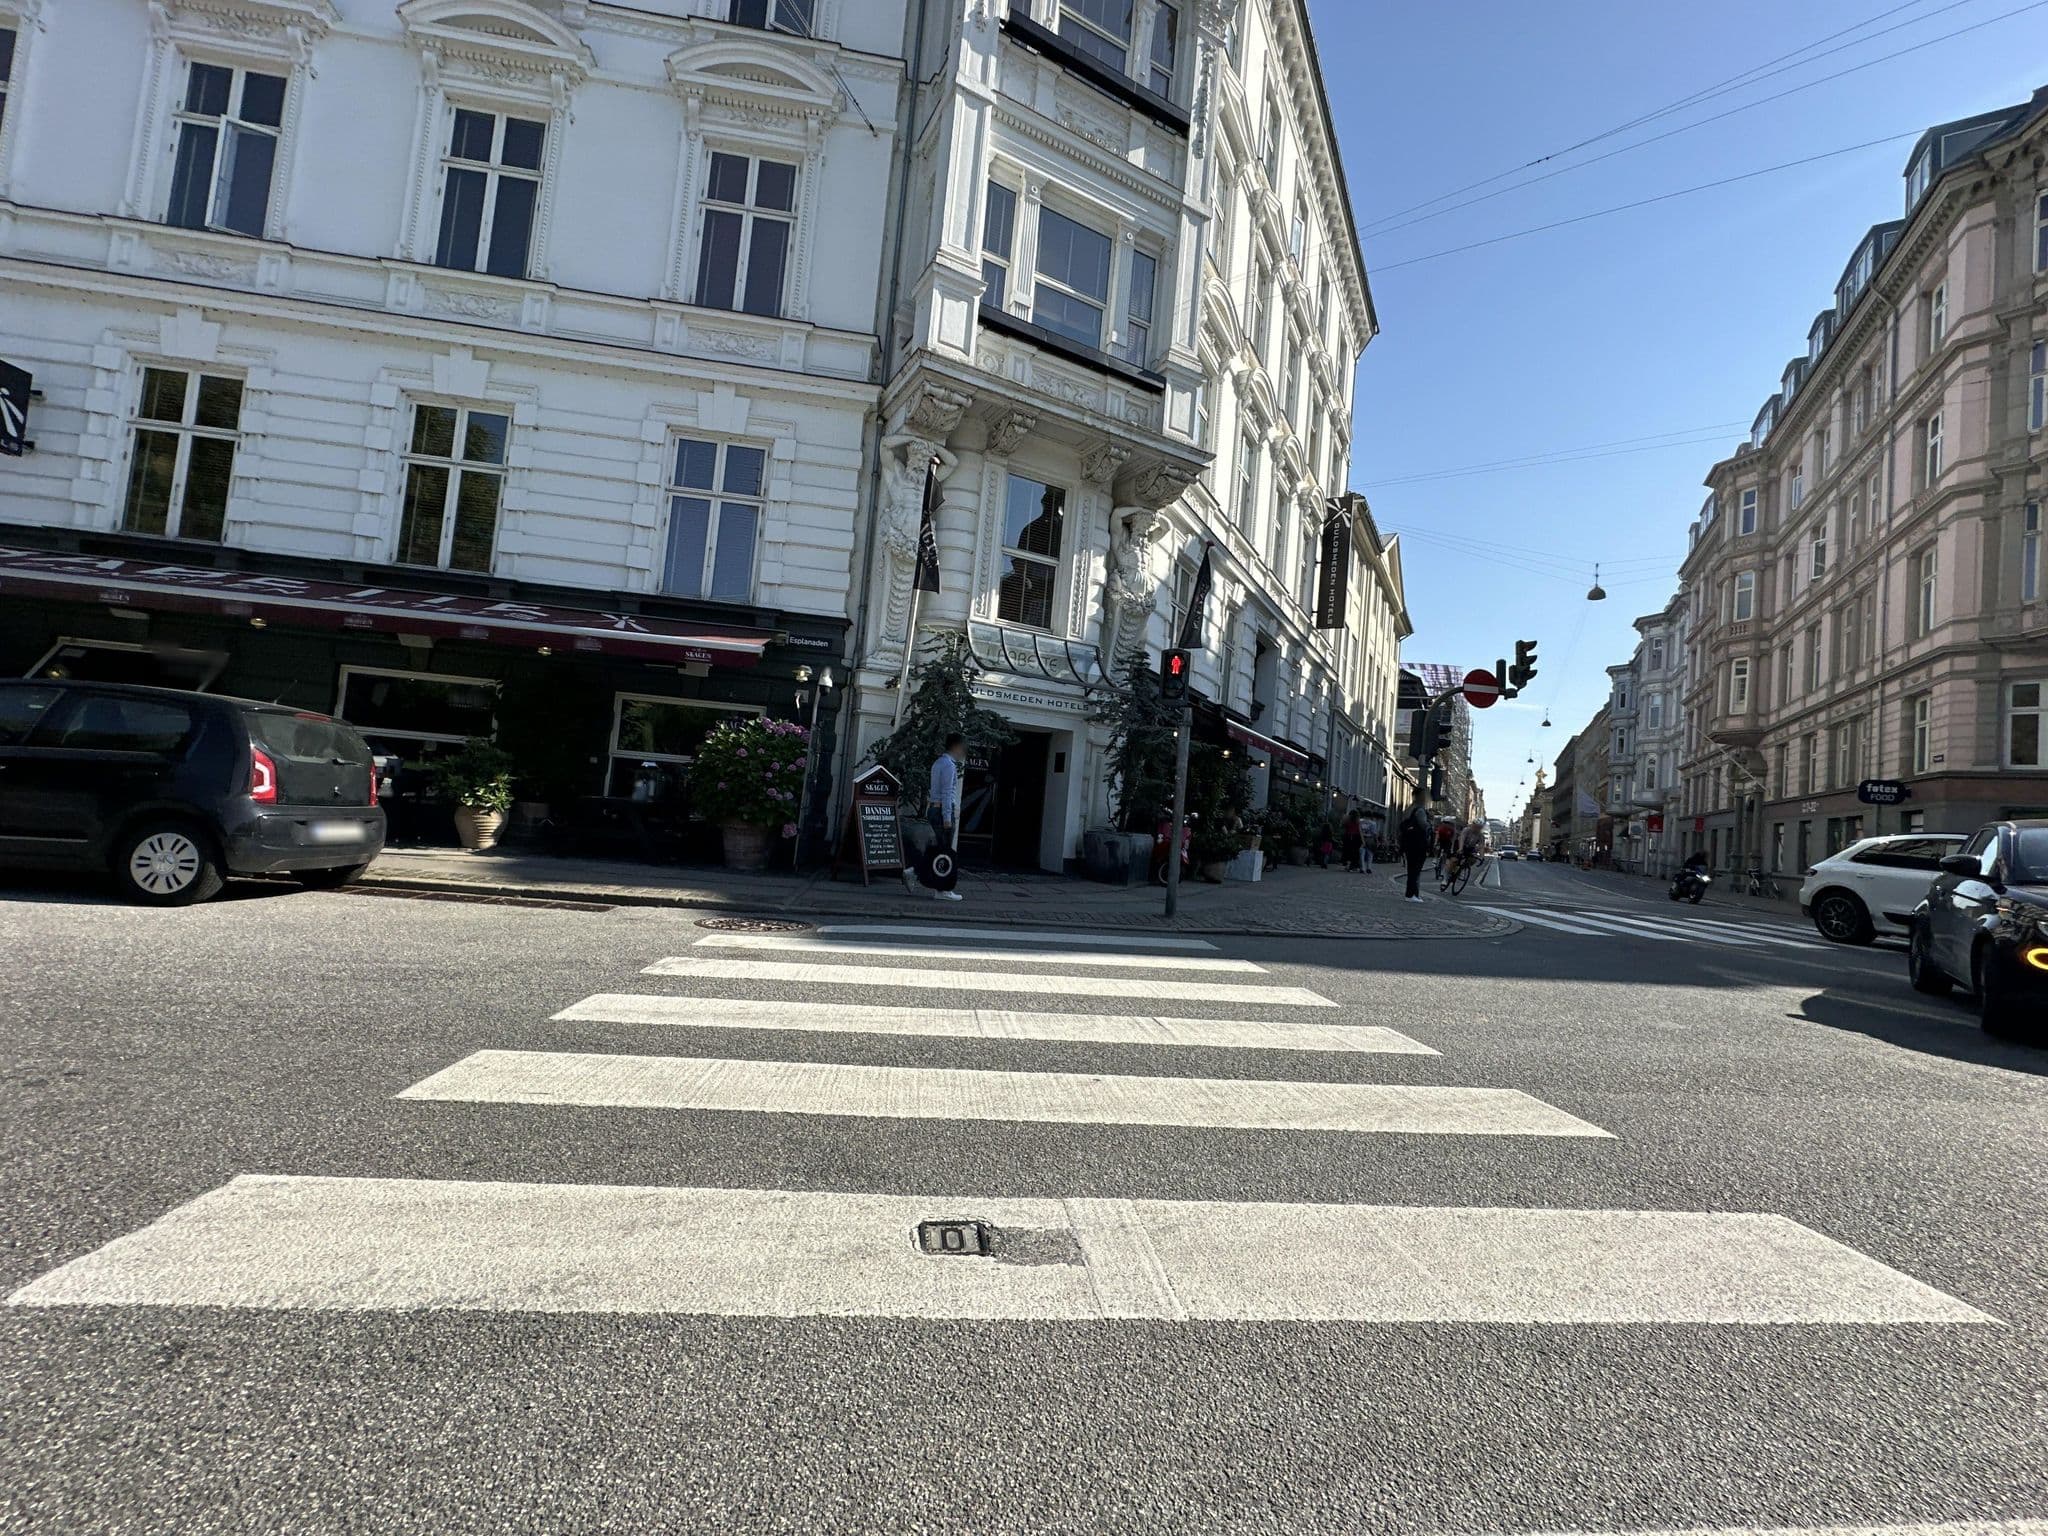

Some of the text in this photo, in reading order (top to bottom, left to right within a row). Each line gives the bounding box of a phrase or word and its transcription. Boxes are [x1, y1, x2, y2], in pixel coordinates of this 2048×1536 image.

[1327, 589, 1336, 625] HOTELS
[789, 636, 829, 648] Esplanaden
[971, 687, 1089, 711] ULDSMEDEN HOTELS
[1870, 793, 1895, 802] FOOD
[864, 806, 891, 815] DANISH
